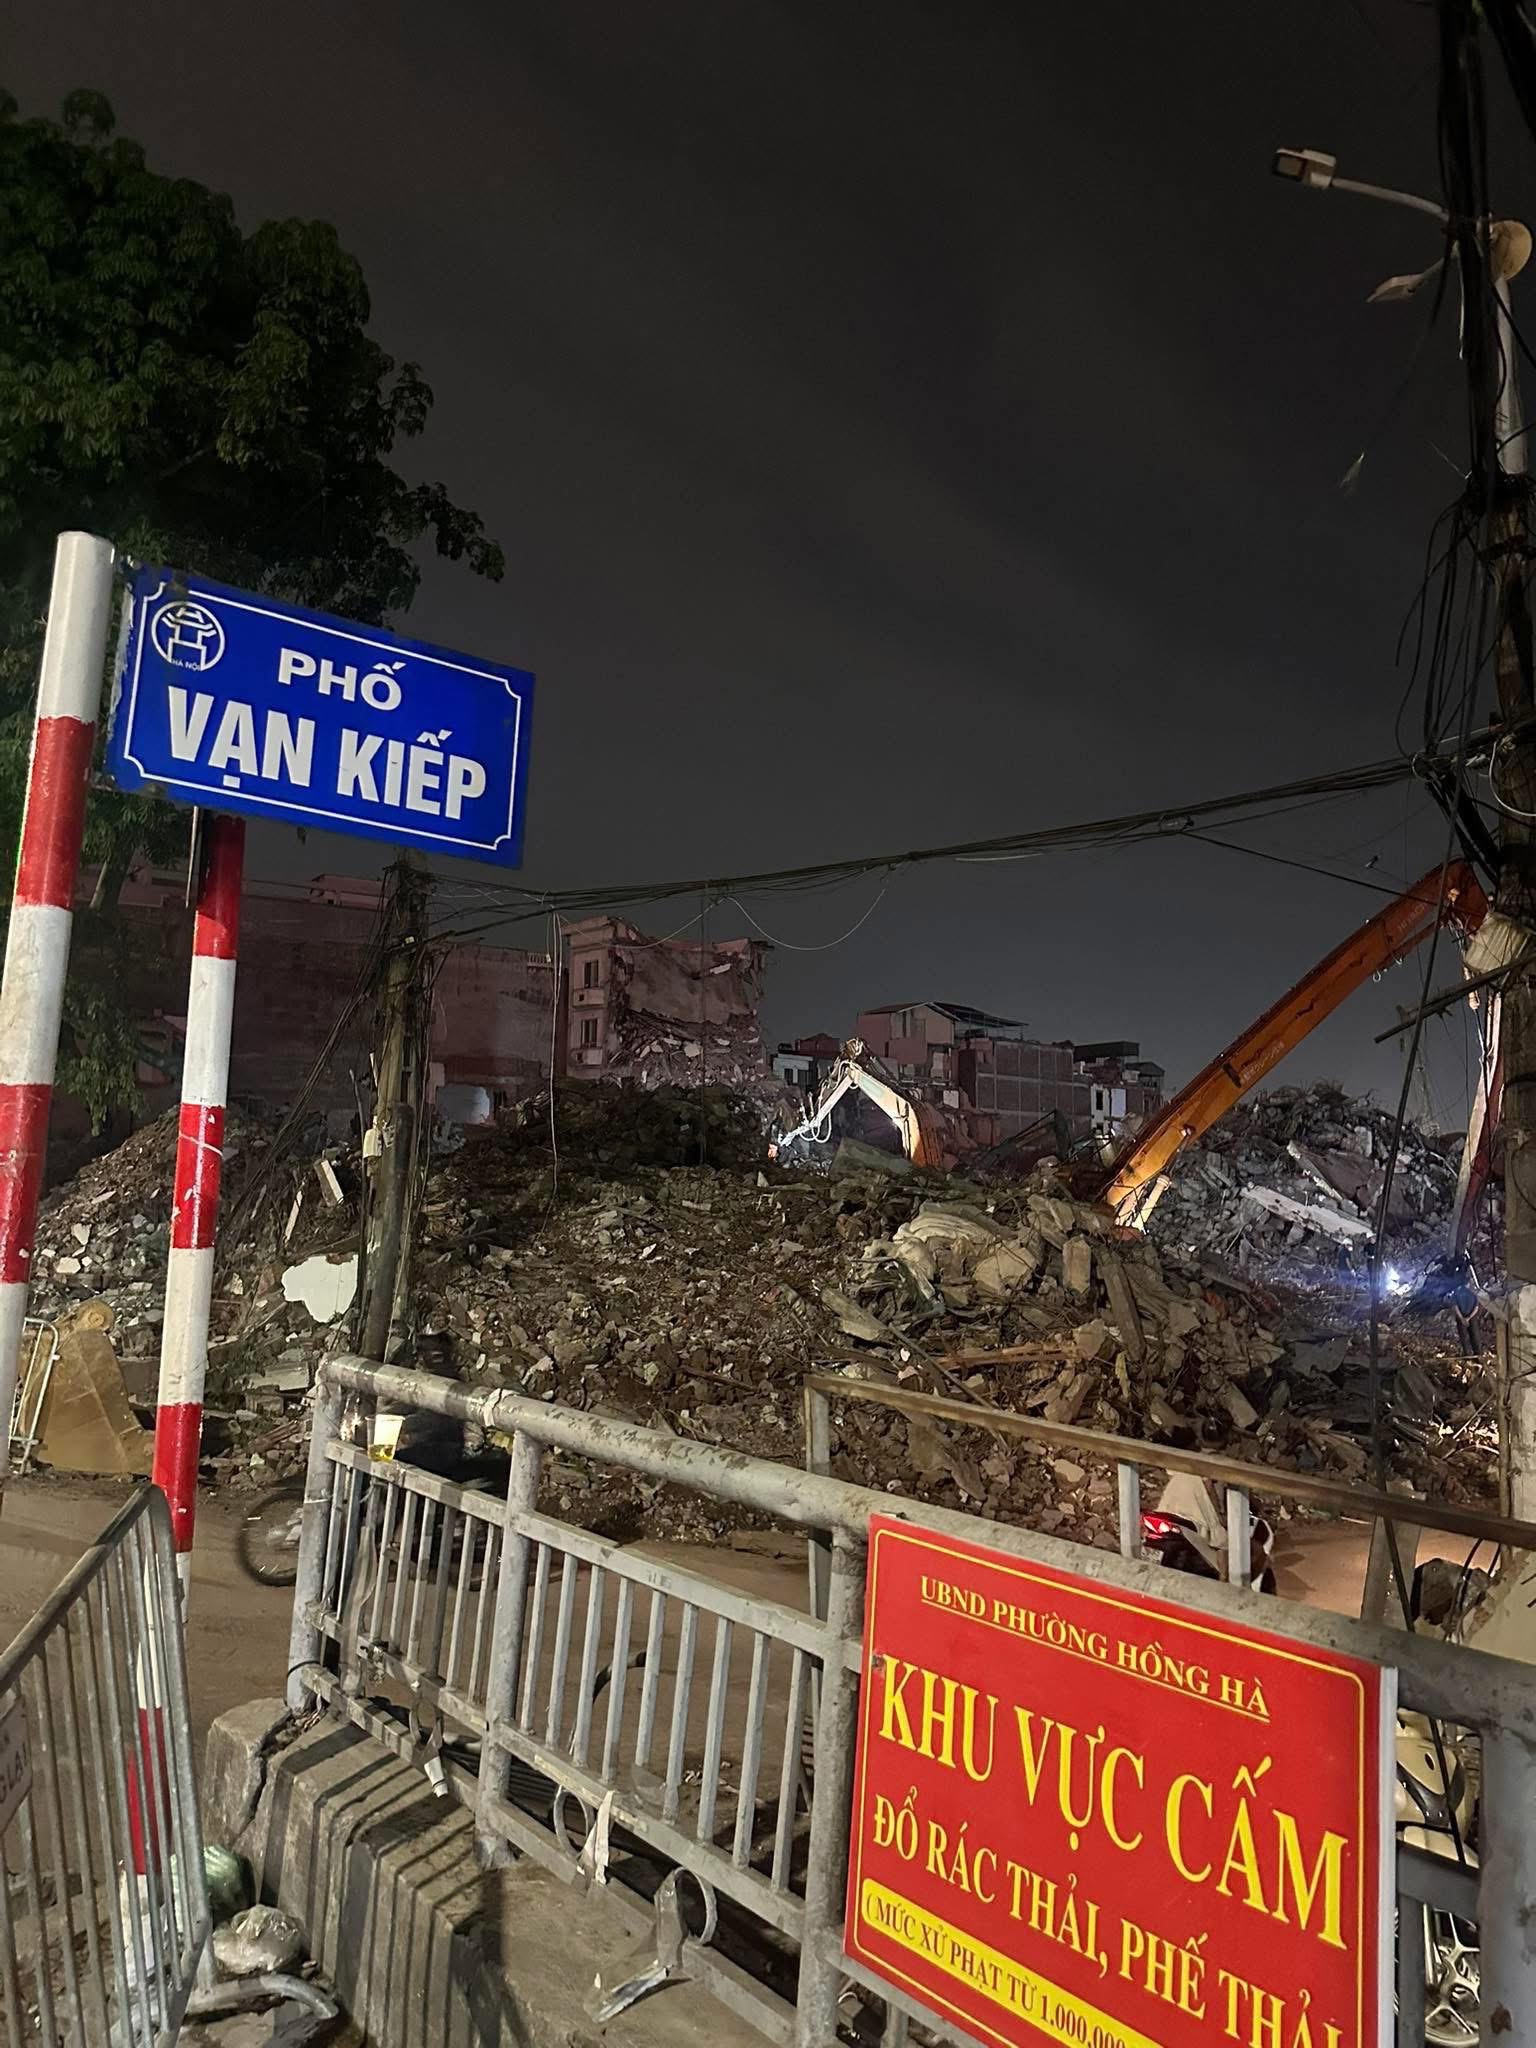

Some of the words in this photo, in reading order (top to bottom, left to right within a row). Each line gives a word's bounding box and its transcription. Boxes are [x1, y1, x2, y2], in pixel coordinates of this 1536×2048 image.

[278, 648, 406, 711] PHỐ
[168, 686, 315, 787] VẠN
[337, 729, 487, 820] KIẾP
[921, 1575, 985, 1615] UBND
[993, 1605, 1107, 1660] PHƯỜNG
[1118, 1643, 1209, 1694] HỒNG
[1220, 1677, 1269, 1715] HÀ
[879, 1654, 998, 1782] KHU
[1014, 1705, 1144, 1851] VỰC
[1165, 1756, 1349, 1949] CẤM
[873, 1786, 919, 1860] ĐỔ
[928, 1822, 998, 1902] RÁC
[1008, 1861, 1107, 1978] THẢI,
[1120, 1918, 1207, 2017] PHẾ
[920, 1921, 948, 1959] XỬ
[950, 1941, 1002, 1990] PHẠT
[1008, 1971, 1038, 2011] TỪ
